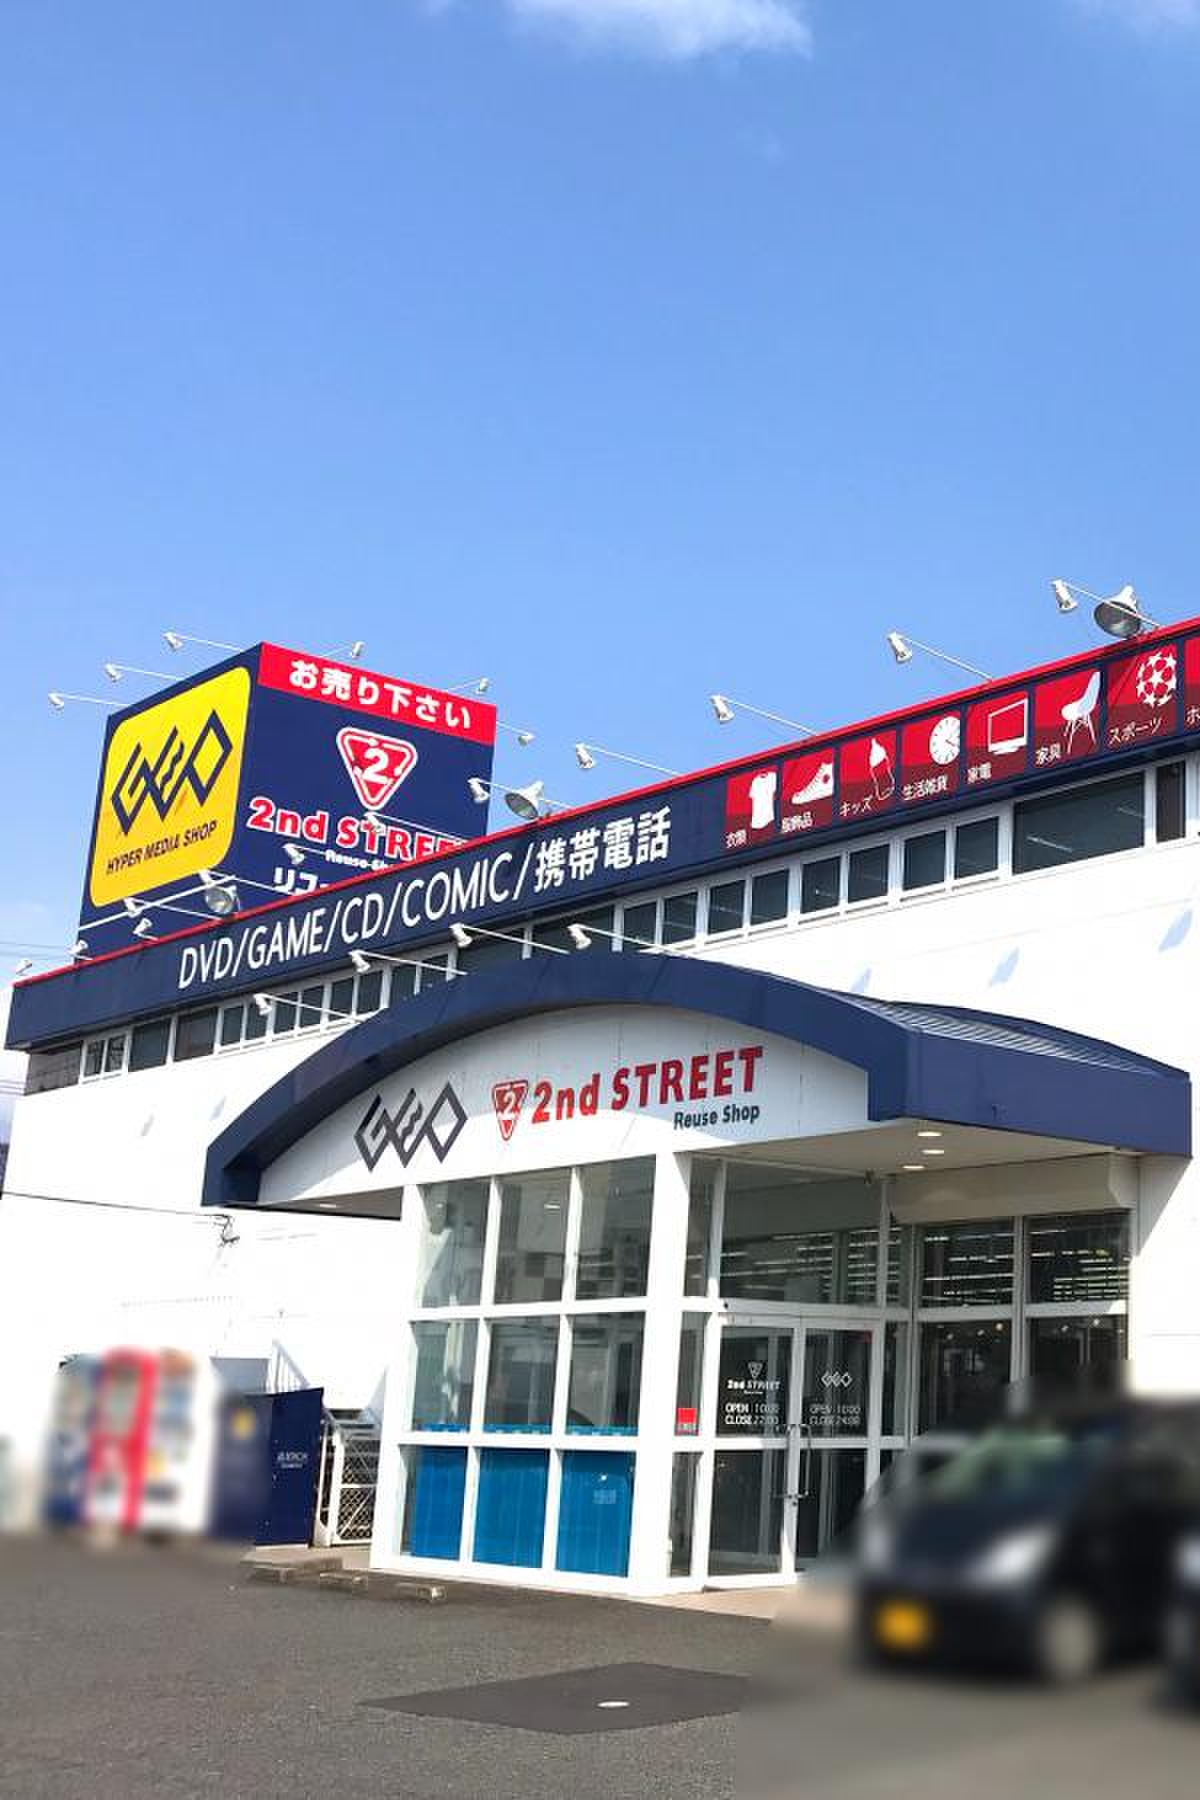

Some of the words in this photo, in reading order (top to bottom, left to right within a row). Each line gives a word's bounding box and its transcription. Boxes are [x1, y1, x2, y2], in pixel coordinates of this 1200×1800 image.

[289, 659, 471, 729] お売り下さい
[1109, 717, 1163, 745] スポーツ
[106, 847, 143, 876] HYPER
[144, 834, 181, 862] MEDIA
[183, 820, 218, 848] SHOP
[246, 796, 329, 844] 2nd
[335, 816, 469, 862] STRE
[531, 1072, 601, 1124] 2nd
[611, 1045, 764, 1111] STREET
[673, 1111, 717, 1130] Reuse
[722, 1103, 761, 1125] Shop
[725, 1402, 749, 1413] OPEN
[725, 1415, 752, 1424] CLOSE
